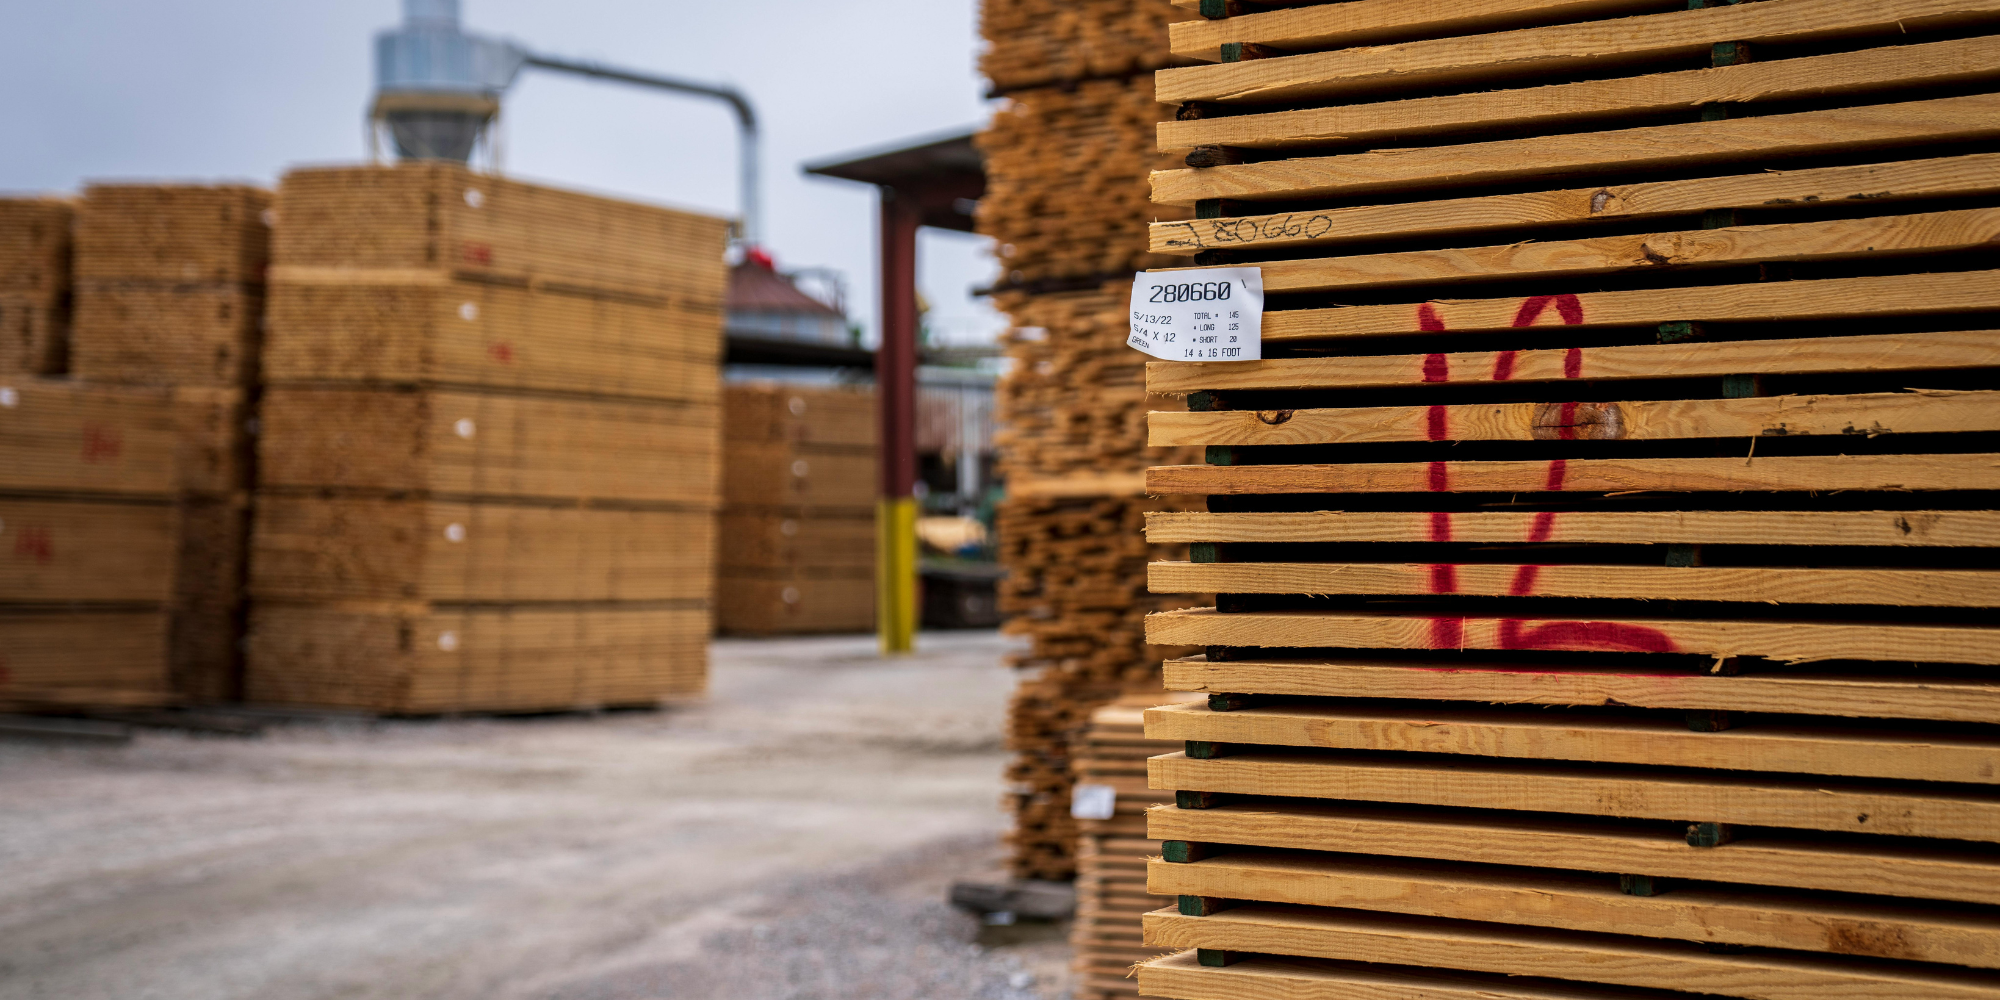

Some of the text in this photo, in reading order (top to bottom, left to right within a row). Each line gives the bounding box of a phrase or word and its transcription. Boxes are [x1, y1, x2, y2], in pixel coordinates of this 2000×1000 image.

[1149, 281, 1231, 303] 280660
[1133, 311, 1172, 325] 5/13/22
[1194, 310, 1239, 320] TOTAL 145
[1199, 322, 1239, 331] LONG 125
[1133, 323, 1176, 343] 5/4 X 12
[1229, 335, 1237, 343] 20
[1131, 335, 1150, 349] GREEN
[1184, 348, 1194, 358] 14
[1208, 348, 1218, 358] 16
[1221, 347, 1241, 357] FOOT
